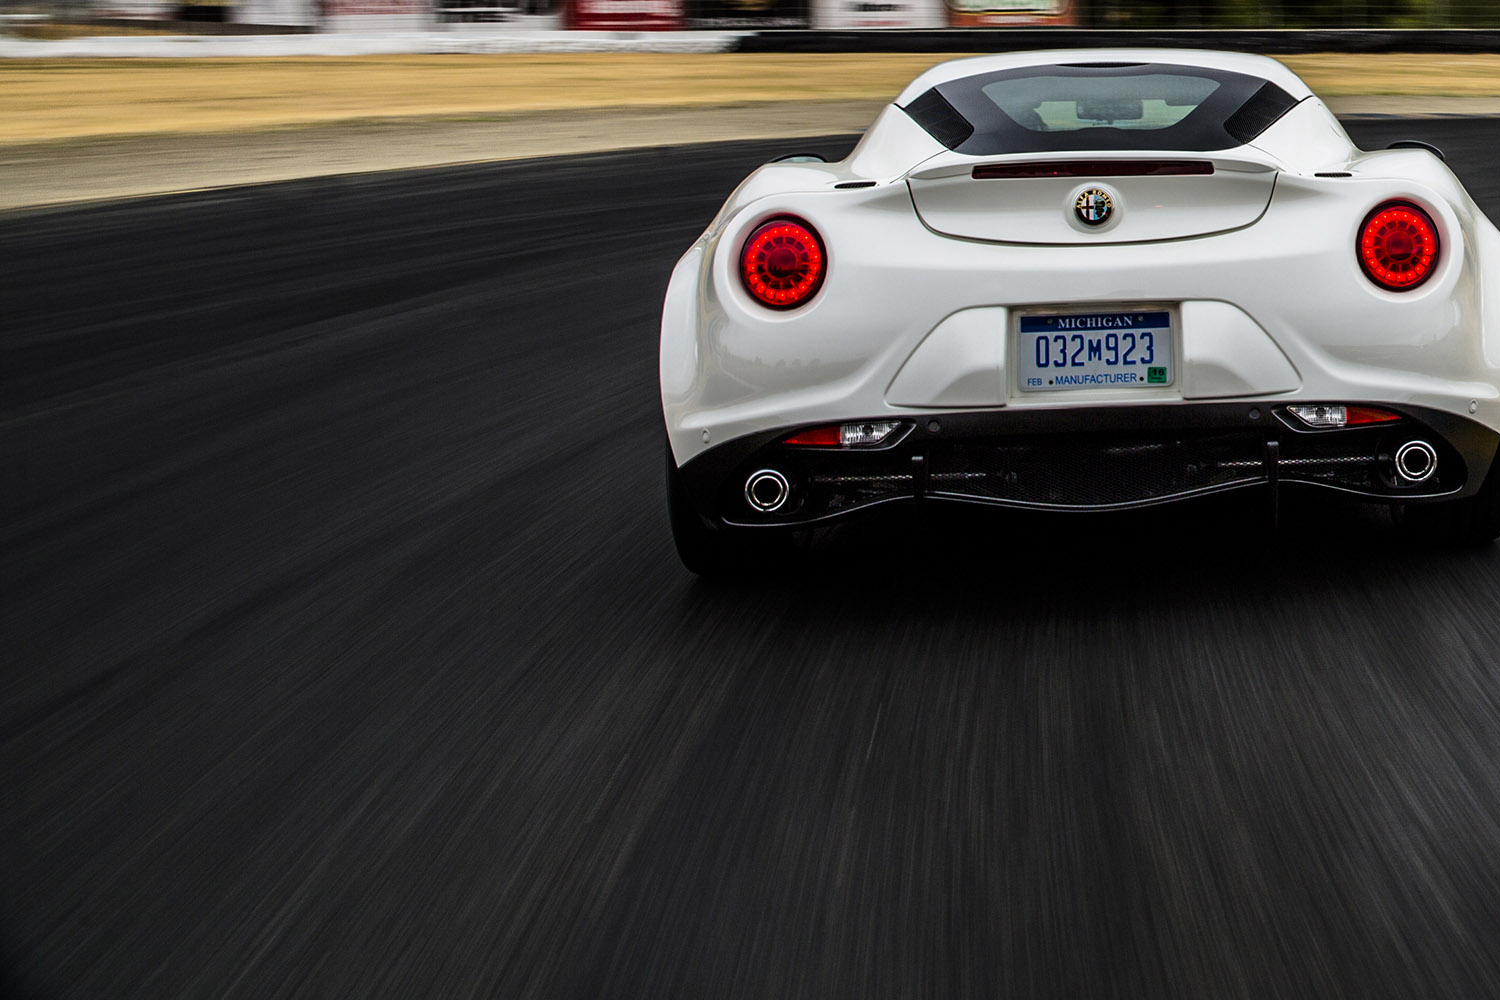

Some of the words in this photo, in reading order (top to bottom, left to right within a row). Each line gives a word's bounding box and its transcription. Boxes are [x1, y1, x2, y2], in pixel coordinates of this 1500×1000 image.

[1075, 191, 1090, 208] ALFA
[1092, 188, 1113, 208] ROMEO
[1057, 316, 1133, 329] MICHIGAN
[1035, 332, 1154, 368] 032M923
[1152, 368, 1165, 376] 16
[1027, 378, 1042, 386] FEB
[1055, 373, 1137, 385] MANUFACTURER
